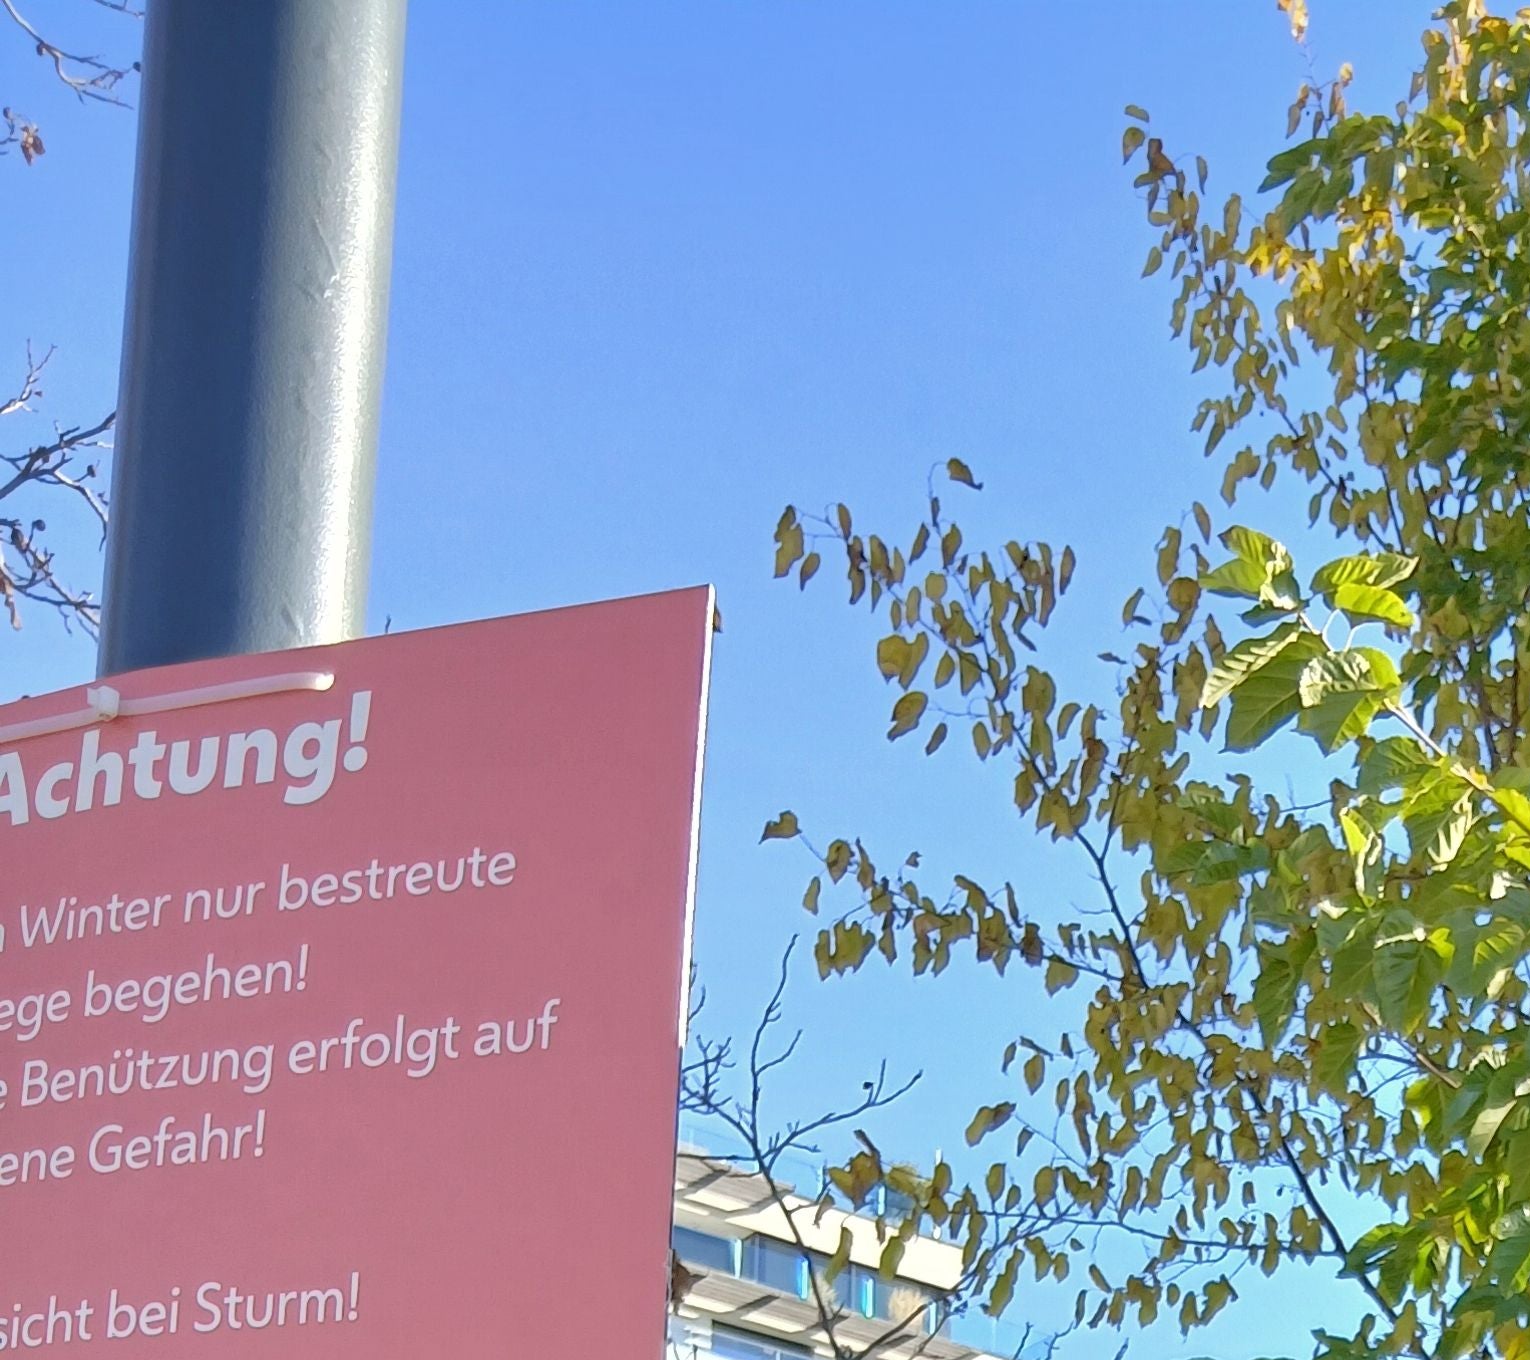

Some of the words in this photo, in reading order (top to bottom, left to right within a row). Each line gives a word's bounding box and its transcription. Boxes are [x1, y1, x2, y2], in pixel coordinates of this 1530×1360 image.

[0, 690, 372, 826] Achtung!
[20, 893, 172, 948] Winter
[184, 881, 266, 923] nur
[278, 847, 517, 911] bestreute
[84, 943, 309, 1023] begehen!
[20, 1045, 275, 1107] Benützung
[288, 1013, 462, 1079] erfolgt
[473, 998, 561, 1056] auf
[88, 1109, 267, 1173] Gefahr!
[106, 1286, 181, 1339] bei
[193, 1271, 361, 1332] Sturm!
